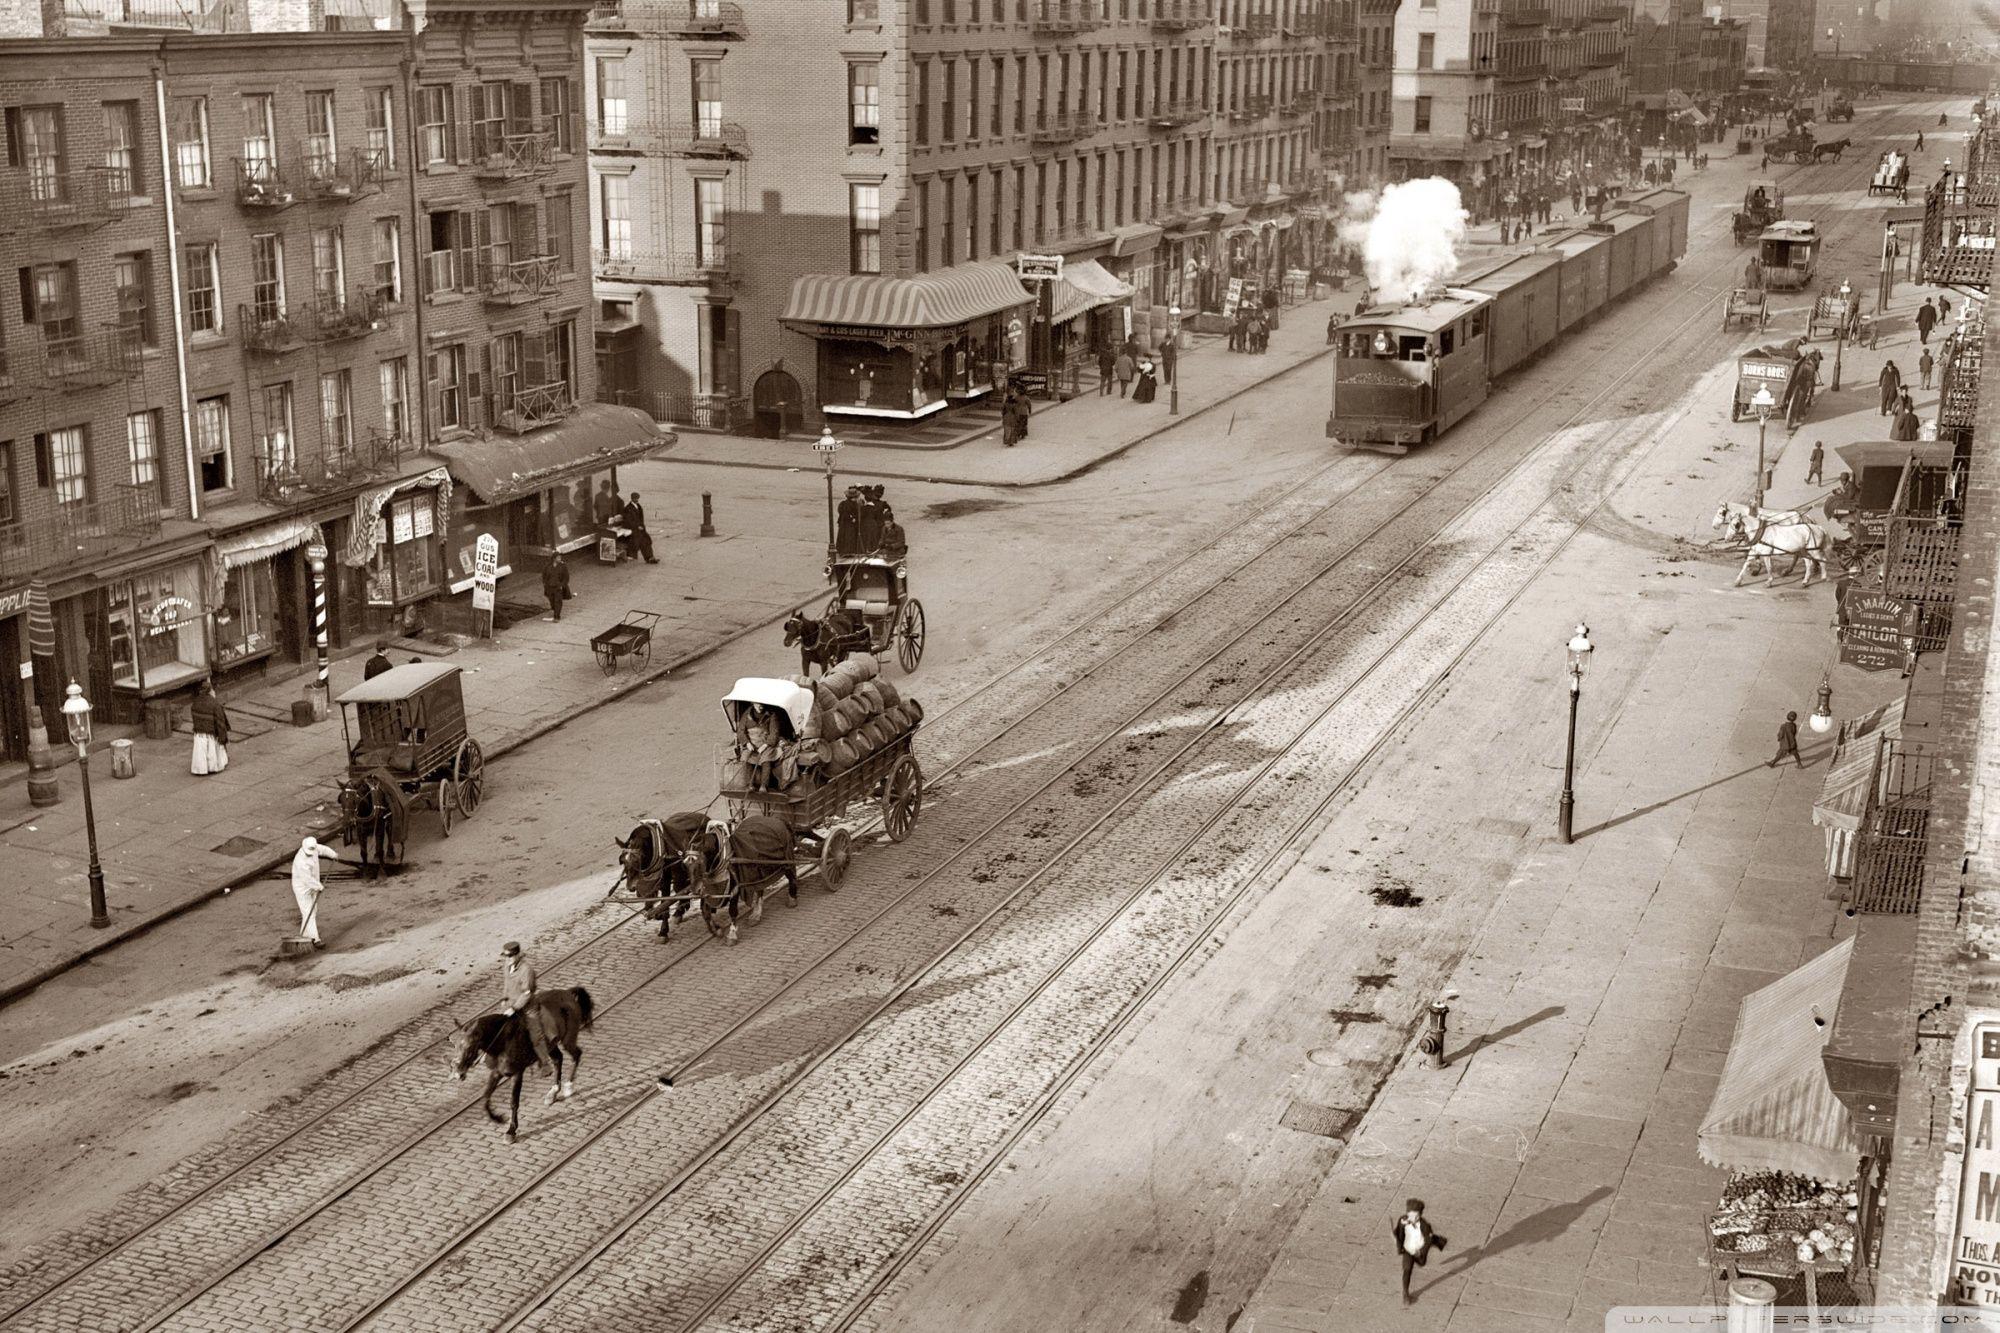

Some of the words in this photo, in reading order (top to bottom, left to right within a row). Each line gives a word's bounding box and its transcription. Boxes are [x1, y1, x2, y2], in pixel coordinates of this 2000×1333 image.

[478, 551, 496, 564] ICE
[475, 562, 496, 576] COAL
[474, 579, 495, 593] WOOD
[0, 589, 31, 615] PPLIE
[1852, 623, 1898, 643] TAILOR
[1857, 654, 1886, 667] 272
